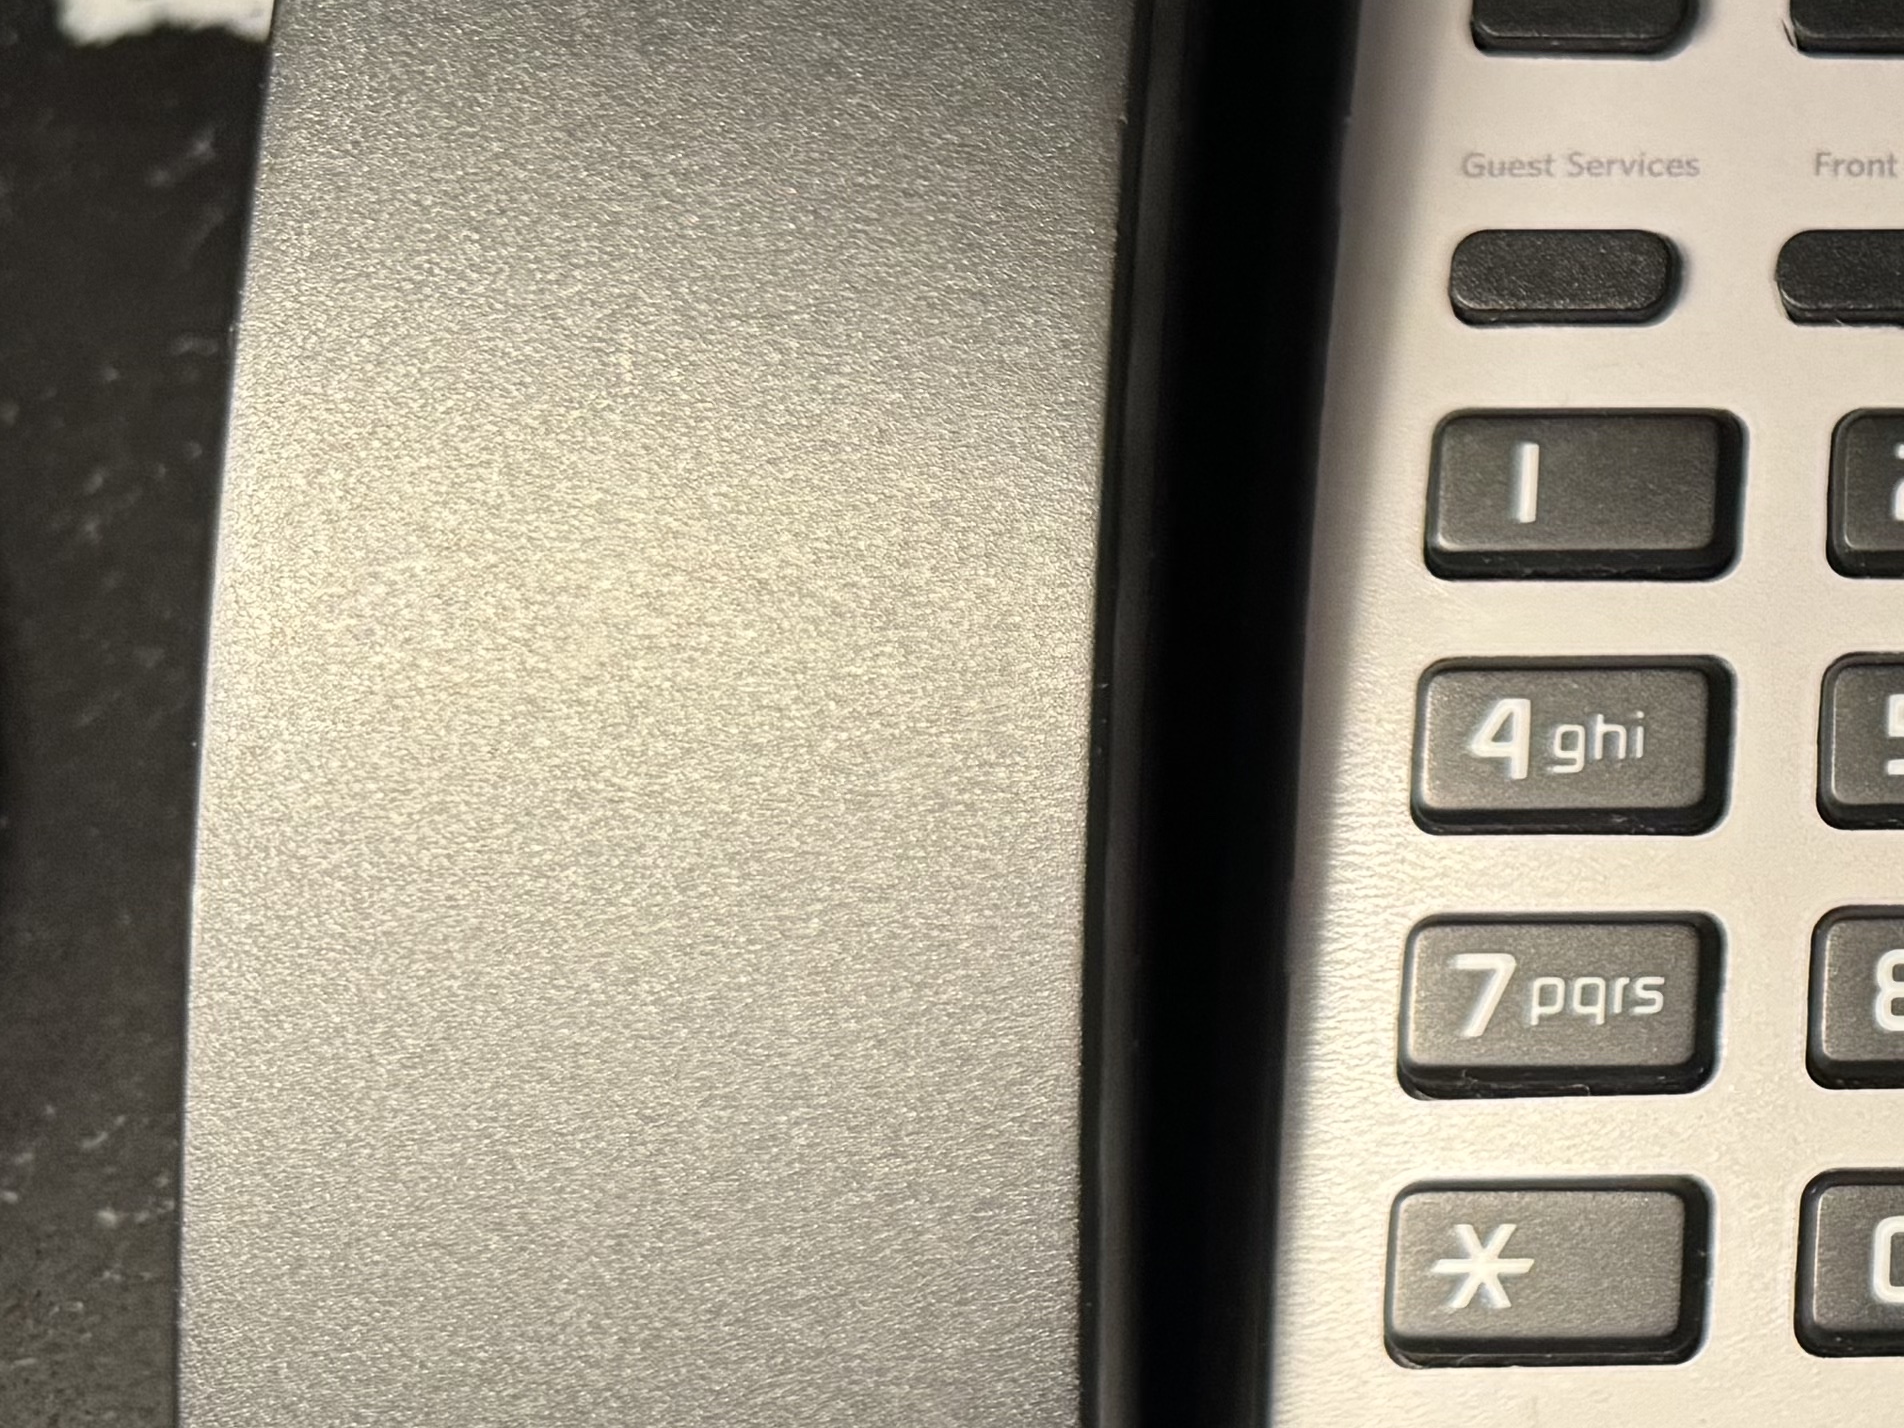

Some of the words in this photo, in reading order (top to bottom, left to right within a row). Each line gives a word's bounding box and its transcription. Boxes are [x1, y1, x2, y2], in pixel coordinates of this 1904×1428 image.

[1461, 152, 1554, 178] Guest
[1567, 152, 1700, 178] Services
[1814, 152, 1897, 178] Front
[1472, 698, 1531, 780] 4
[1549, 711, 1646, 773] ghi
[1452, 953, 1516, 1038] 7
[1528, 976, 1665, 1026] pqrs
